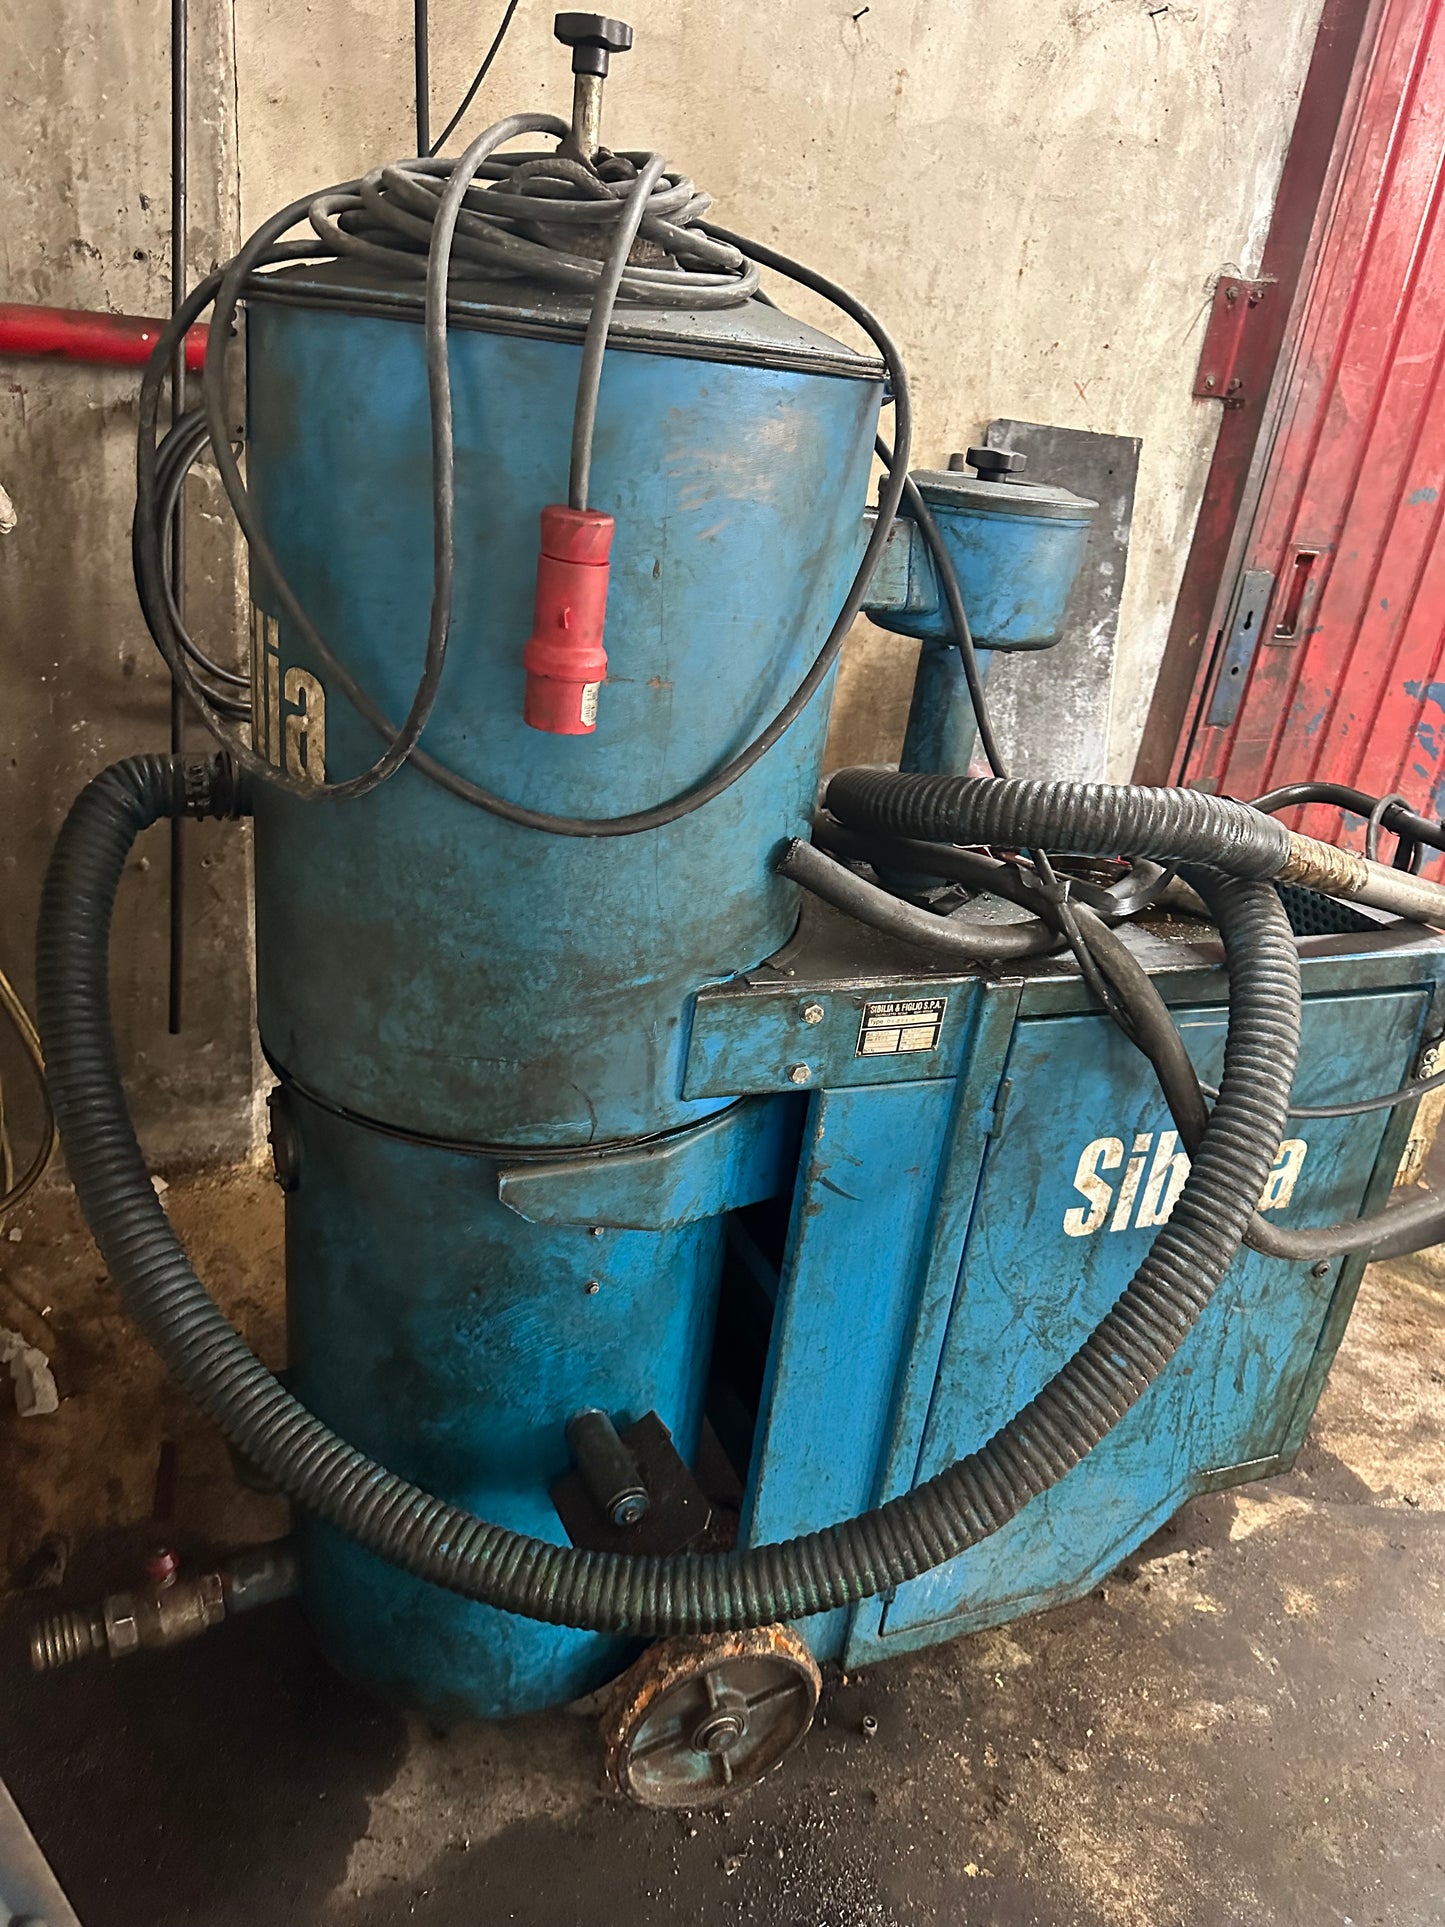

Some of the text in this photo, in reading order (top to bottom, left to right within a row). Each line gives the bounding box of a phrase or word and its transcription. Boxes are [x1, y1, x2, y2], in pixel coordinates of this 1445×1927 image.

[870, 1004, 894, 1014] SIBILIA
[895, 1004, 901, 1012] &
[902, 1002, 923, 1011] FIGLIO
